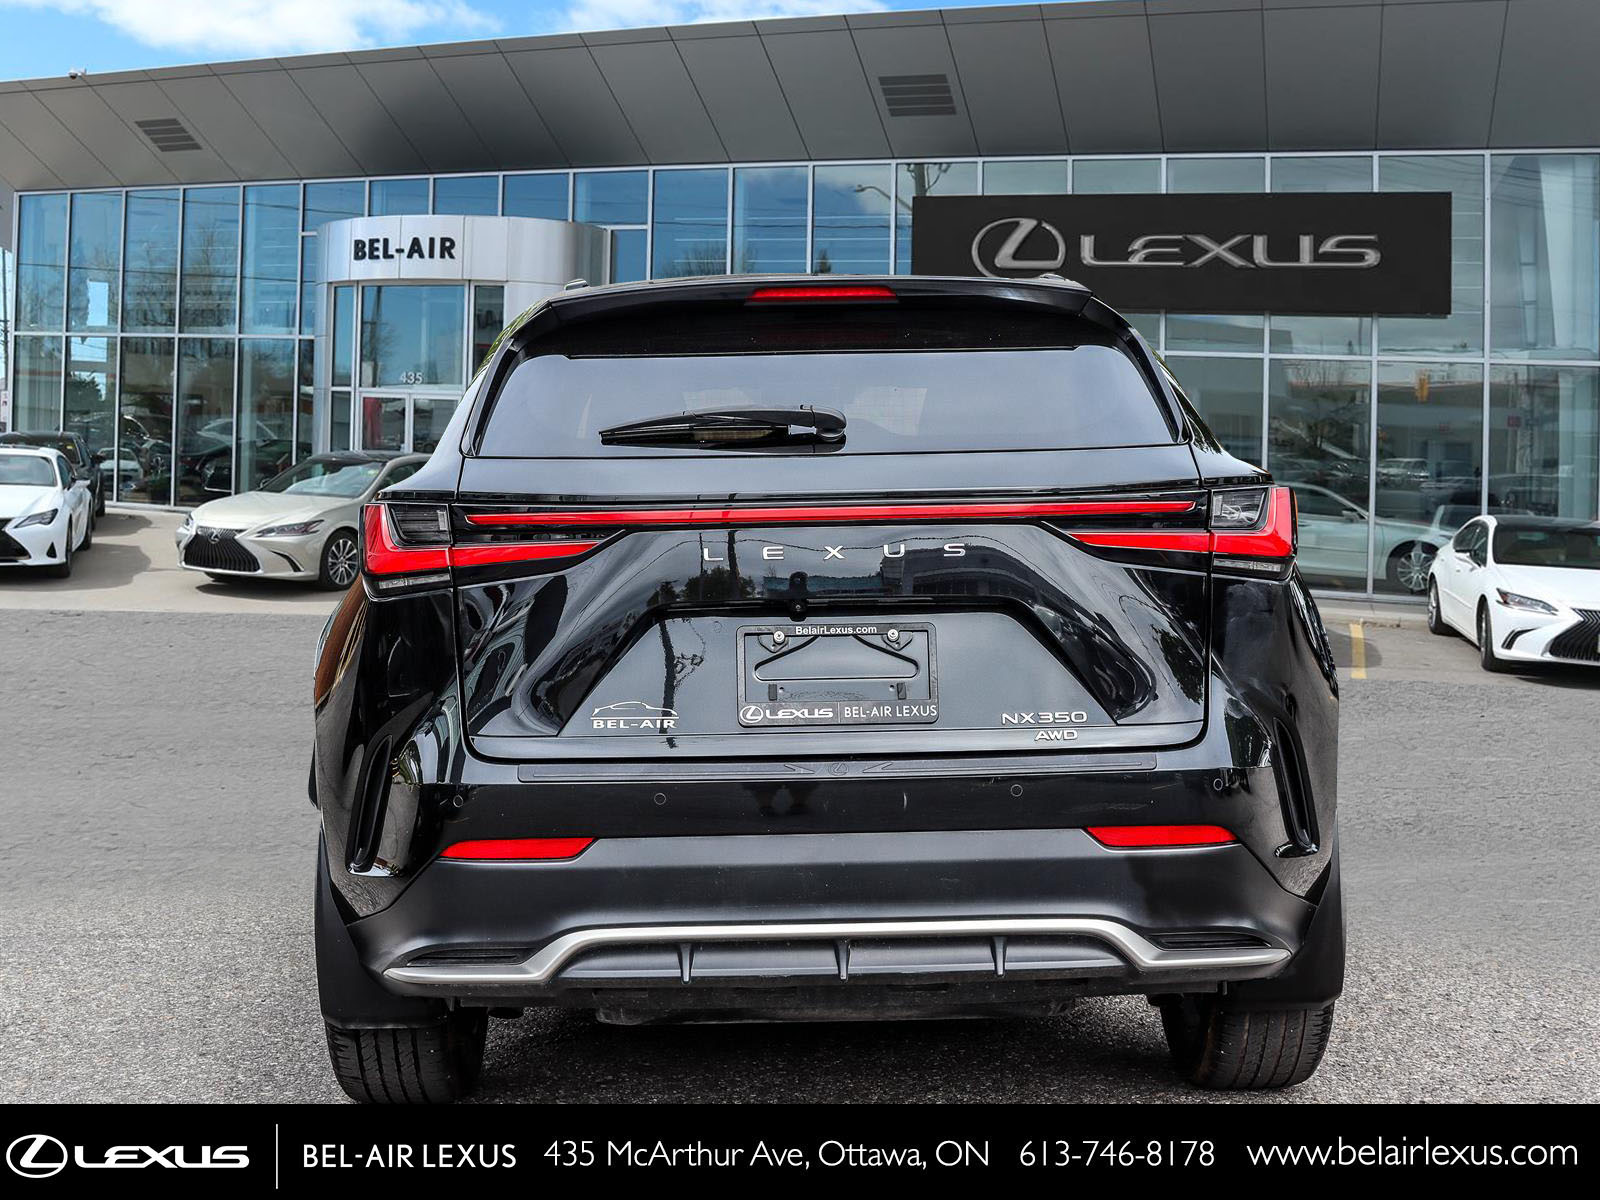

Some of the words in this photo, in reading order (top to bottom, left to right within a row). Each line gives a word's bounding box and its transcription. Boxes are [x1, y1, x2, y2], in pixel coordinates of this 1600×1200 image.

[353, 237, 456, 261] BEL-AIR
[1080, 233, 1381, 269] LEXUS
[400, 371, 423, 384] 435
[703, 543, 966, 561] LEXUS
[795, 625, 877, 635] BelairLexus.com
[766, 708, 833, 718] LEXUS
[844, 706, 892, 718] BEL-AIR
[896, 704, 937, 716] LEXUS
[593, 719, 677, 729] BEL-AIR
[1035, 729, 1079, 741] AWD
